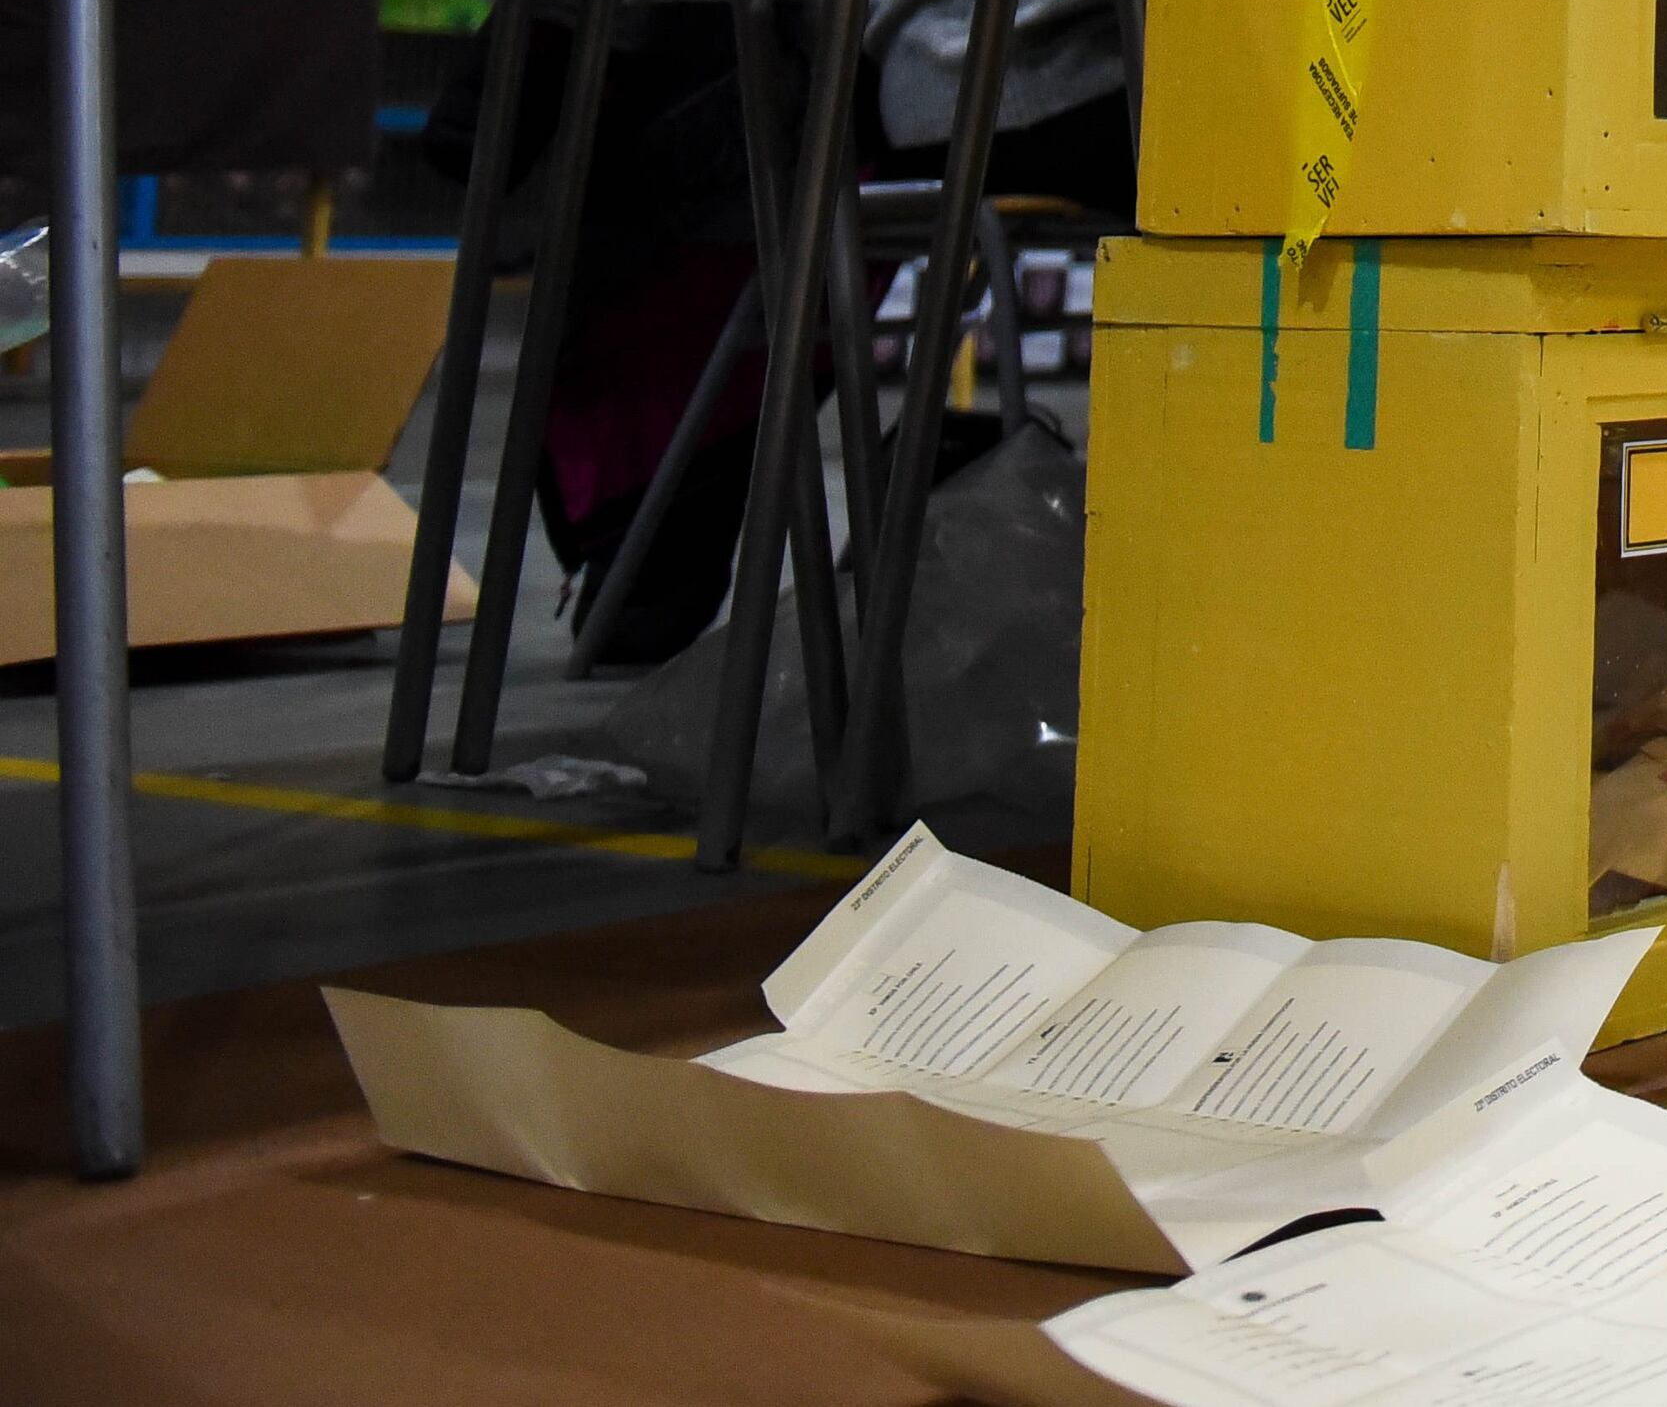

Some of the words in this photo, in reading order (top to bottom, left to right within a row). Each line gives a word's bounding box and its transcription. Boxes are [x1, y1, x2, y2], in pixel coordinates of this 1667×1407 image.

[1307, 155, 1334, 193] SER
[861, 870, 890, 901] DISTRITO
[888, 835, 925, 873] ELECTORAL
[1484, 1078, 1518, 1106] DISTRITO
[1516, 1053, 1562, 1085] ELECTORAL
